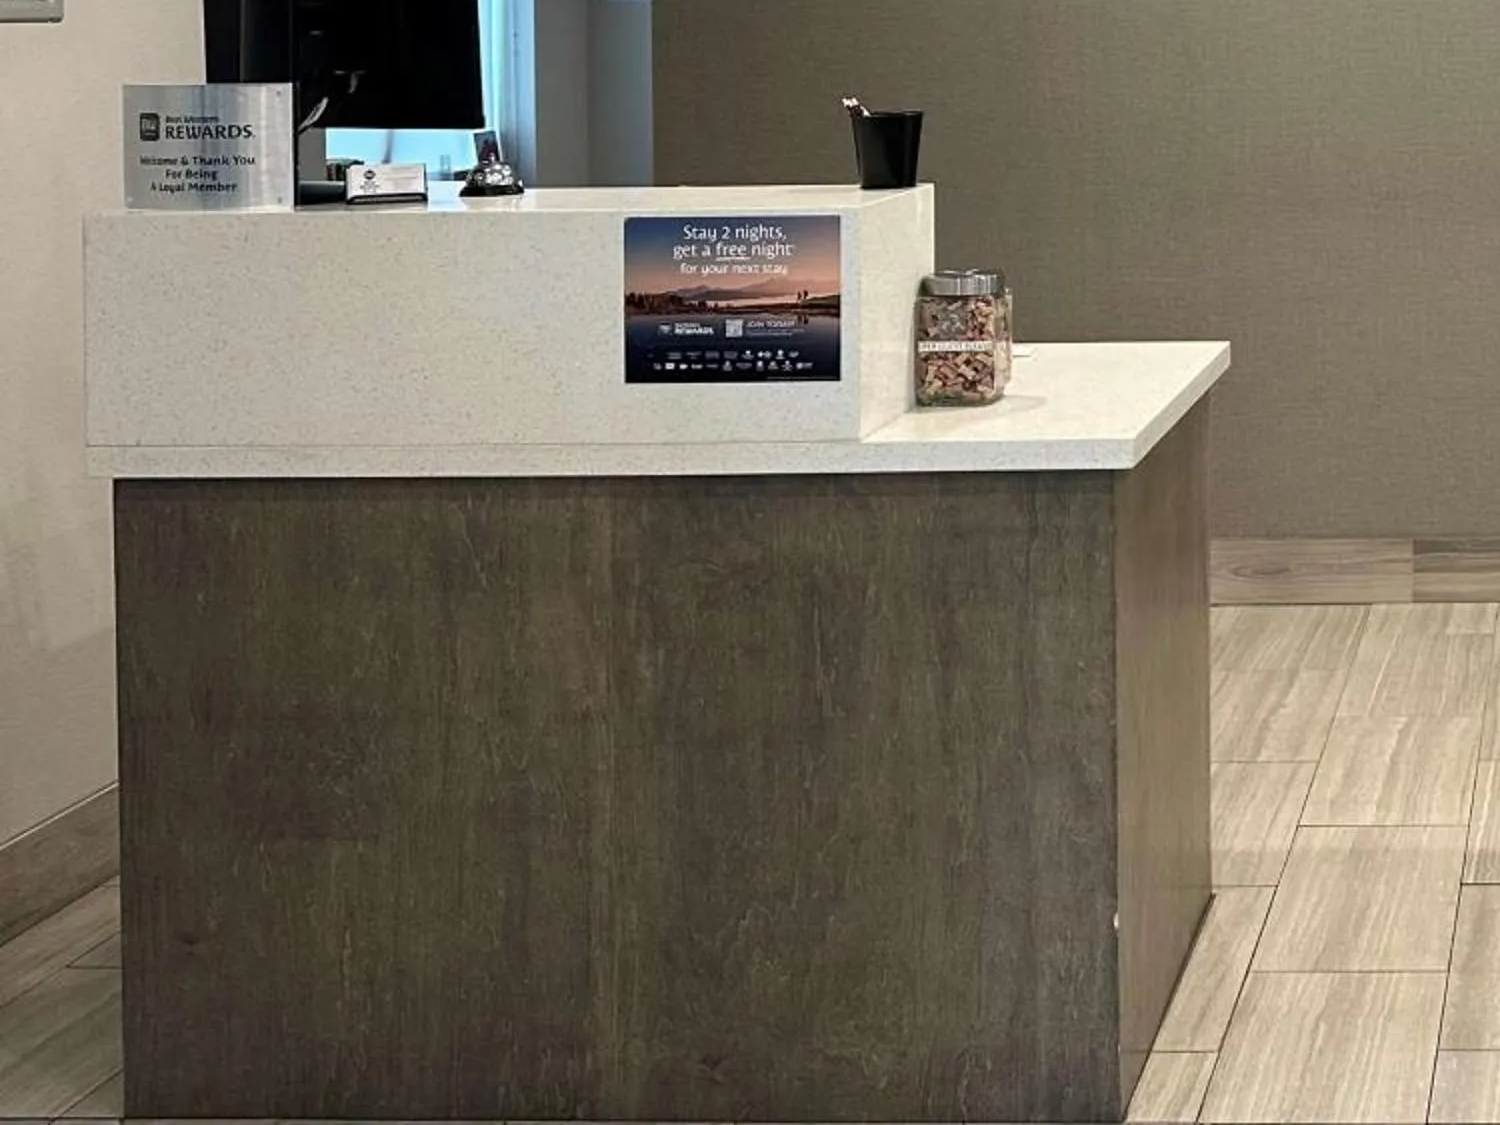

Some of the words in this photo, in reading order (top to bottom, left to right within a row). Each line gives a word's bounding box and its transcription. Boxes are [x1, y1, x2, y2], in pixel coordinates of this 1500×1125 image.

[165, 124, 253, 139] REWARDS
[192, 155, 230, 166] Thank
[233, 155, 256, 166] You
[166, 169, 183, 179] For
[185, 169, 218, 181] Being
[159, 182, 185, 194] Loyal
[187, 182, 238, 192] Member
[683, 224, 717, 242] Stay
[721, 226, 731, 240] 2
[735, 223, 787, 242] nights,
[673, 244, 698, 260] get
[701, 244, 711, 256] a
[716, 241, 747, 256] free
[680, 263, 698, 274] for
[701, 264, 729, 277] your
[732, 264, 759, 274] next
[762, 264, 788, 275] stay
